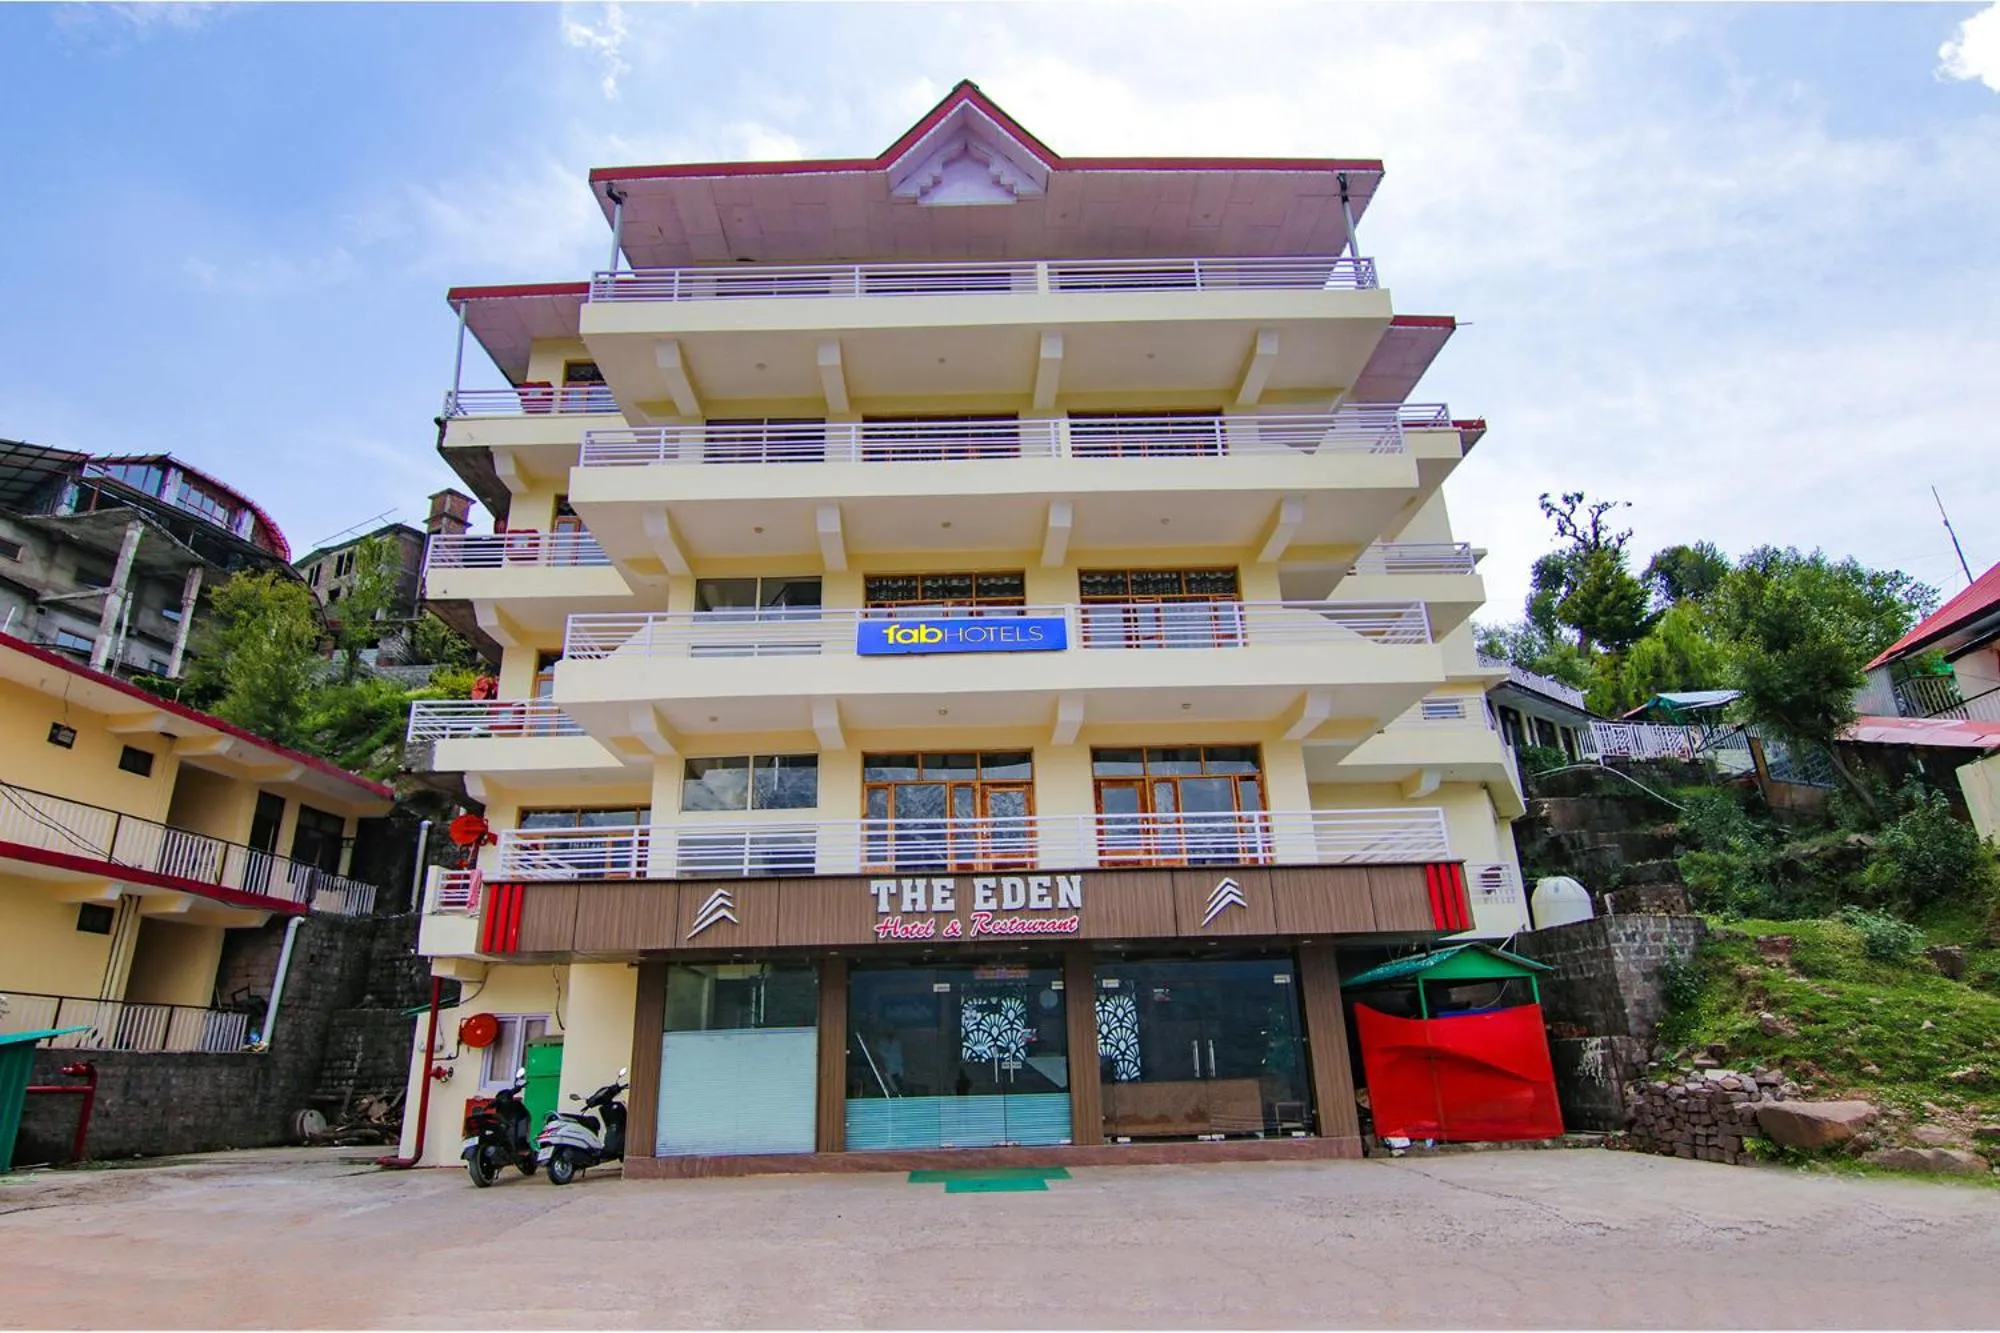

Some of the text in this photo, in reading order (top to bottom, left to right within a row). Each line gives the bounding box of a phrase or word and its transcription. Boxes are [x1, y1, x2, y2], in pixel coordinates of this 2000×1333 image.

[883, 623, 1043, 644] fabHOTELS
[870, 875, 1082, 912] THE EDEN
[875, 911, 1079, 938] Hotel & Restaurant
